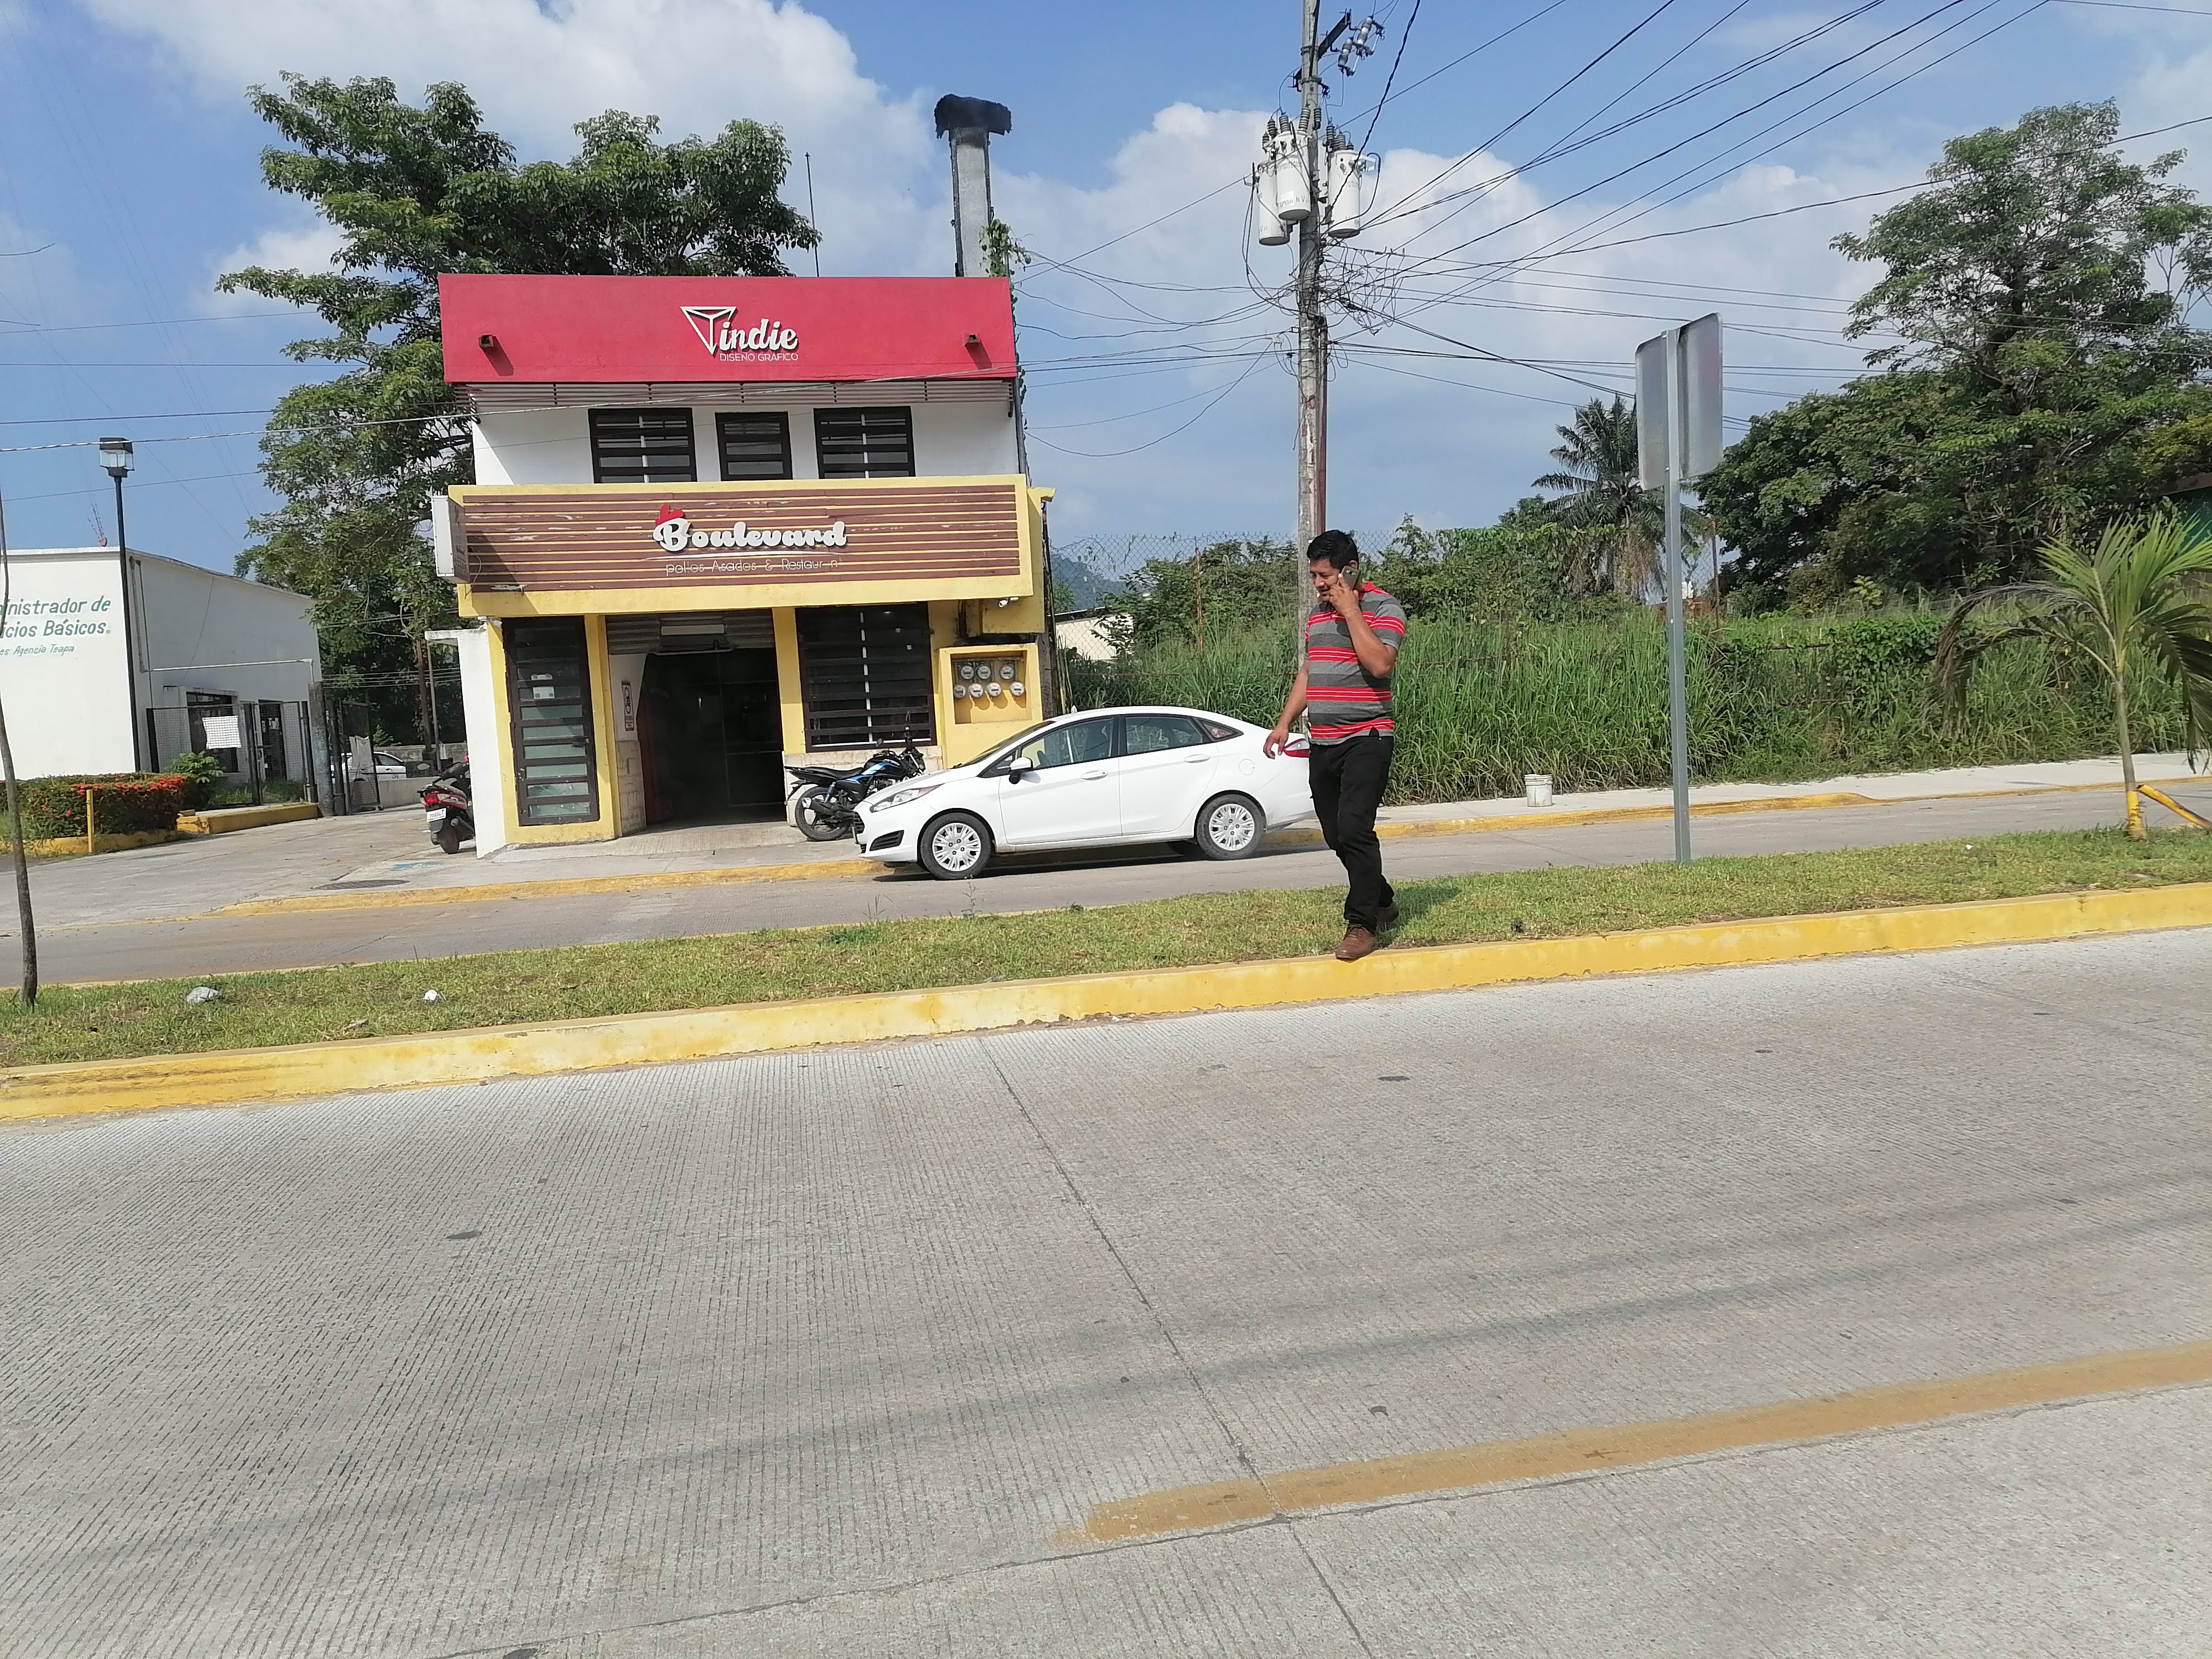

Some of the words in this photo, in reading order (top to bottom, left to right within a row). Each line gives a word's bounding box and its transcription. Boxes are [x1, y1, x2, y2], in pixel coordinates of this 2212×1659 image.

[653, 518, 847, 552] Boulevard
[712, 559, 757, 573] Asados
[765, 559, 773, 571] &
[91, 595, 111, 612] de
[13, 644, 46, 656] Agencia
[50, 644, 75, 656] Teapa
